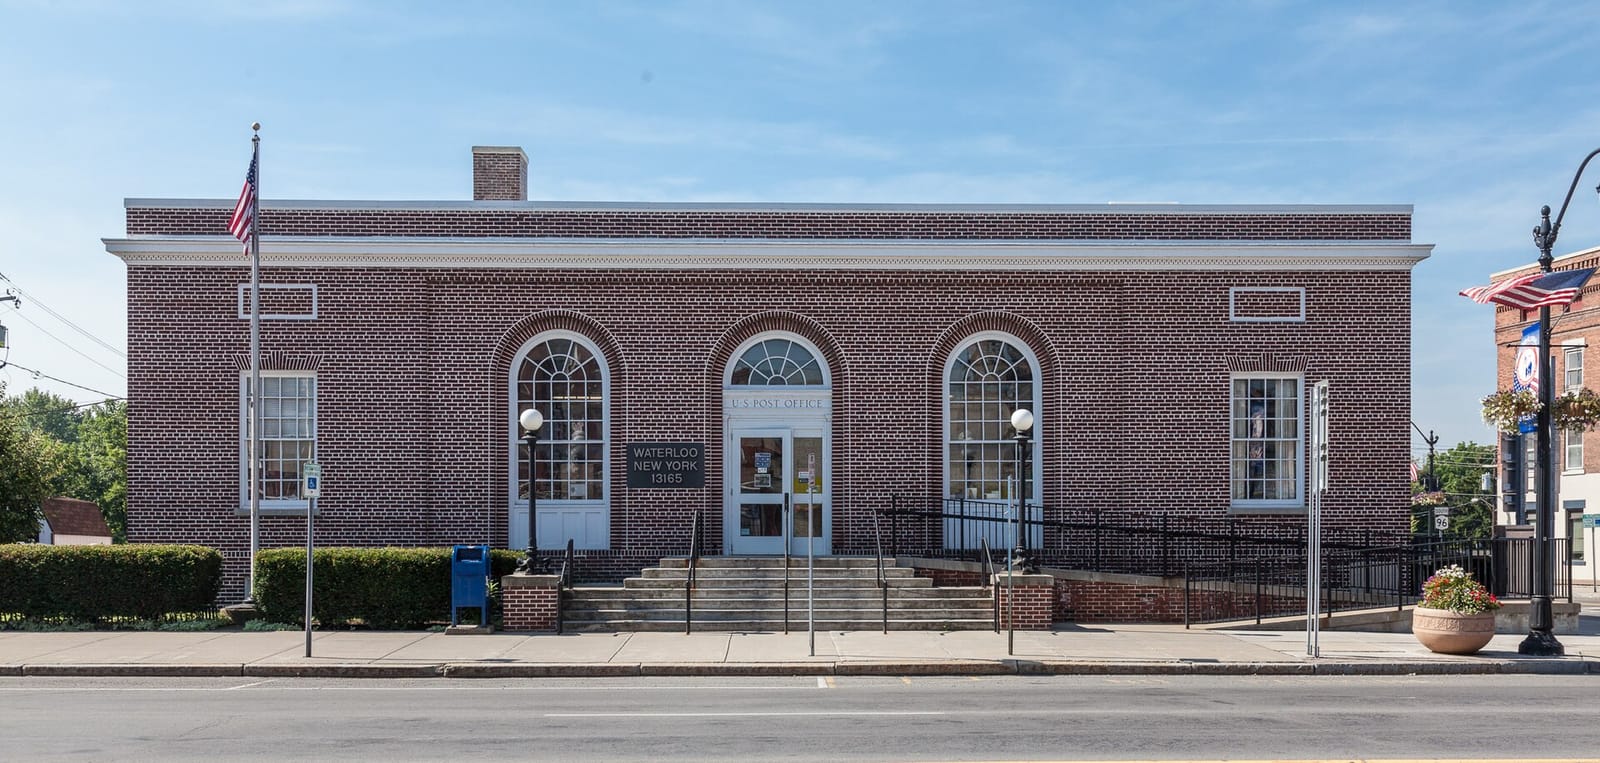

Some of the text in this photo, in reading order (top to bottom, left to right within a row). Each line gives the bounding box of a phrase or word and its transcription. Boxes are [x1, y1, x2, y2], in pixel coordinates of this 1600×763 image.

[753, 399, 780, 408] POST
[784, 399, 823, 408] OFFICE
[633, 447, 698, 458] WATERLOO
[633, 461, 698, 471] NEW YORK
[651, 473, 683, 484] 13165
[1436, 518, 1448, 527] 96
